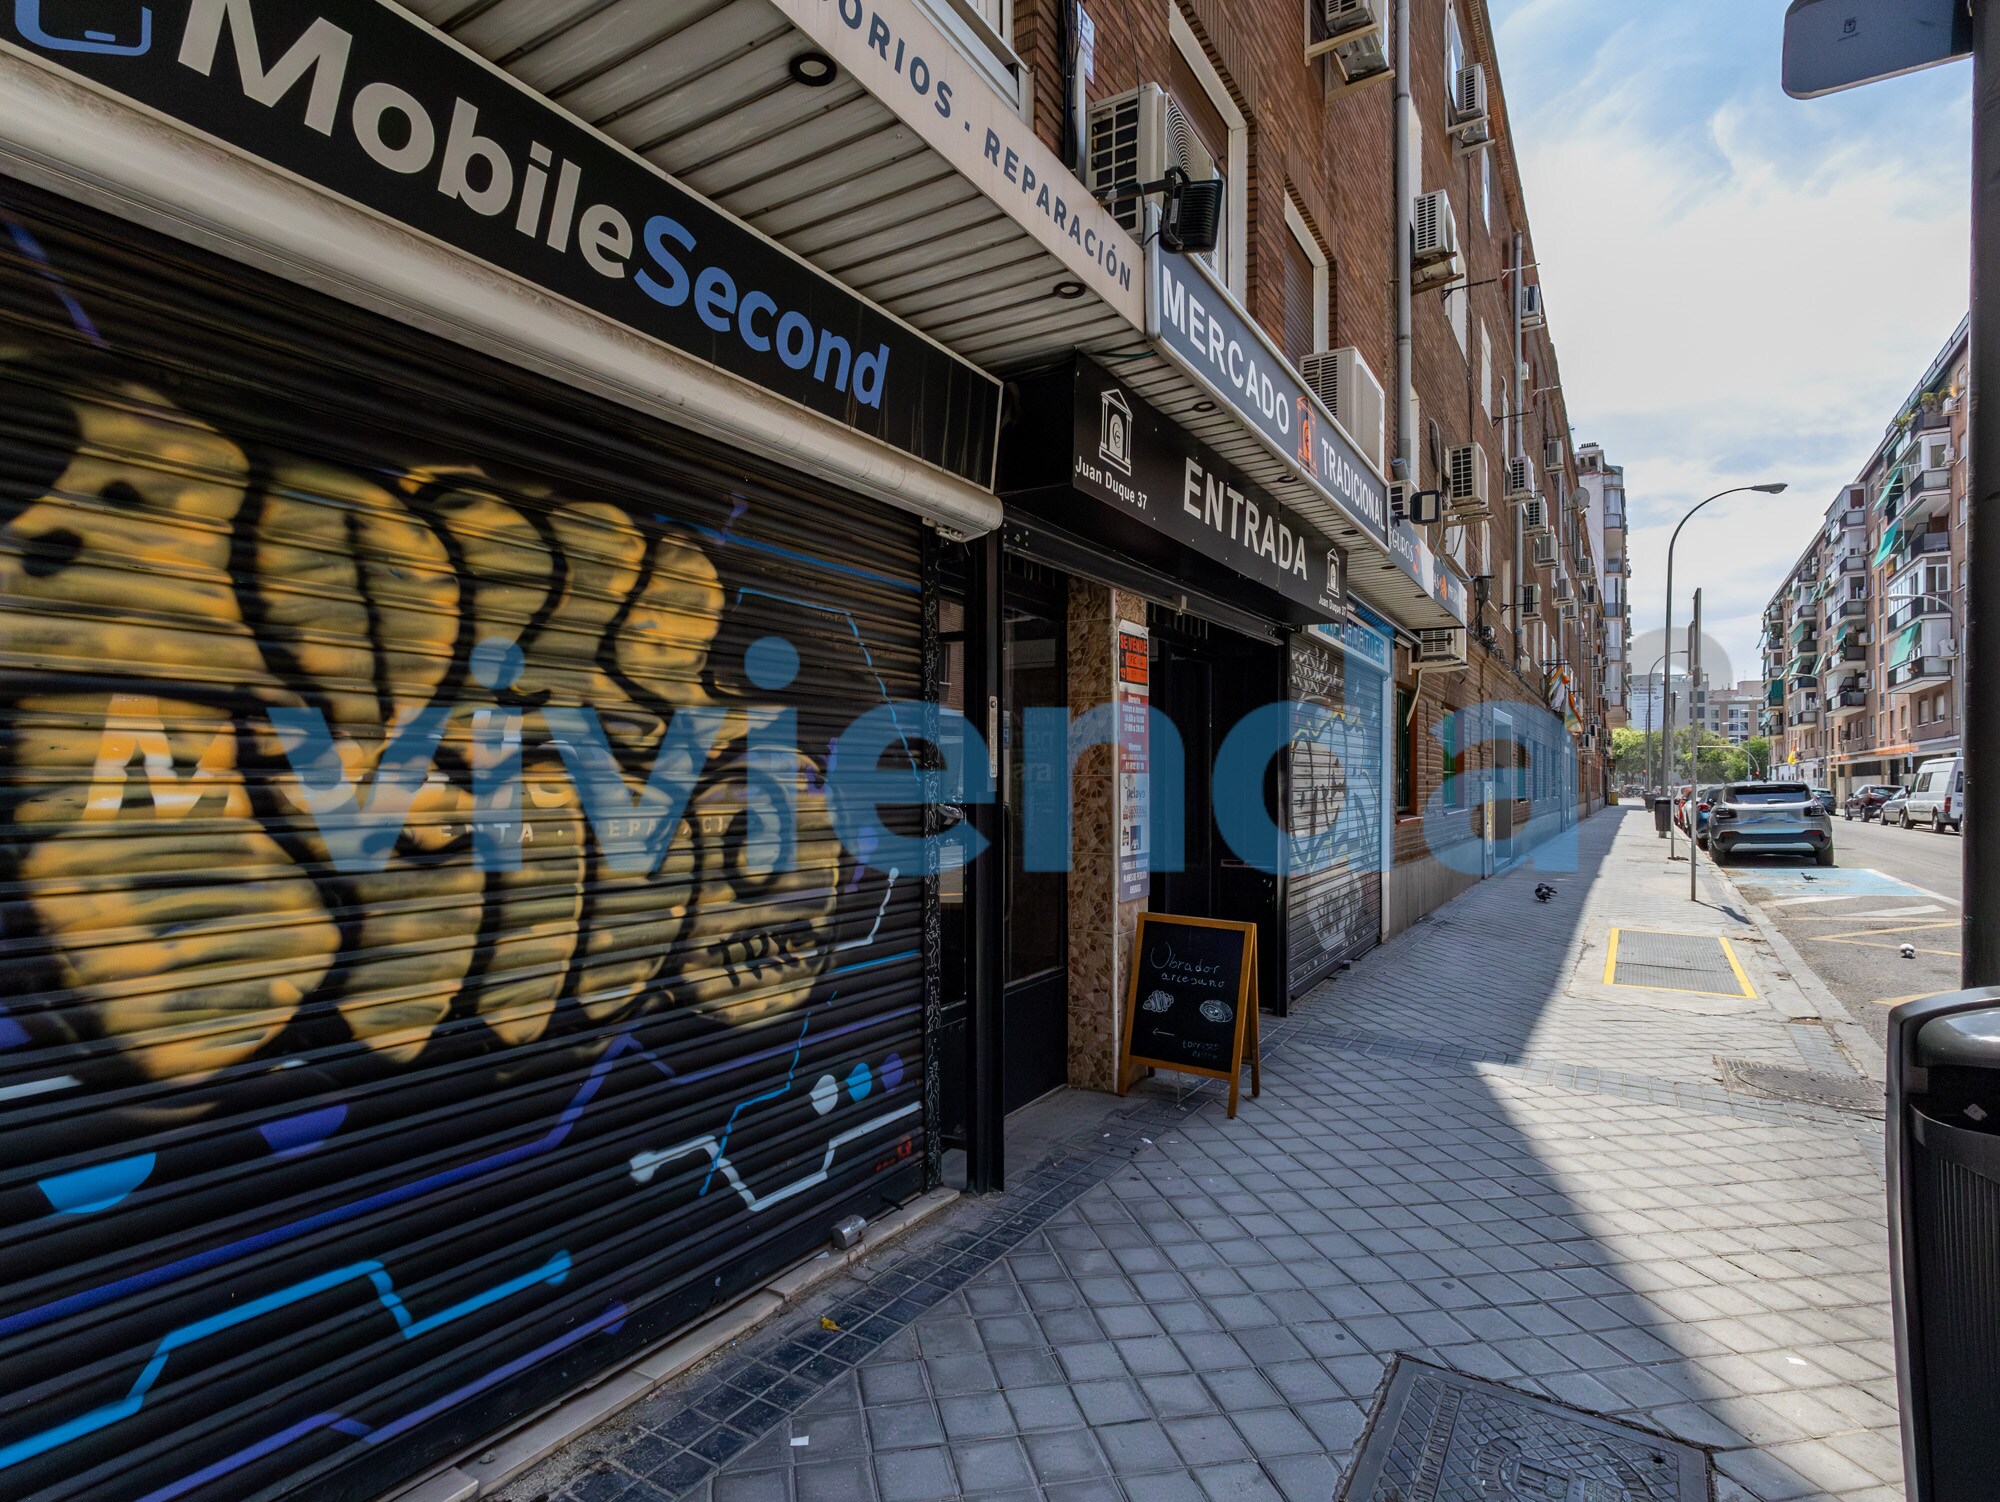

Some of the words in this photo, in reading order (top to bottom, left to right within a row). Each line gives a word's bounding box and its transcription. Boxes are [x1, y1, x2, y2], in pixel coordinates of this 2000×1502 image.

[838, 0, 953, 118] ORIOS
[984, 129, 1132, 292] REPARACIÓN
[178, 0, 889, 409] MobileSecond
[1162, 265, 1290, 436] MERCADO
[1321, 438, 1386, 532] TRADICIONAL
[1075, 456, 1102, 484] Juan
[1105, 471, 1135, 503] Duque
[1137, 491, 1147, 510] 37
[1183, 457, 1308, 581] ENTRADA
[1120, 634, 1128, 650] SE
[1128, 636, 1147, 655] VENDE
[1318, 594, 1329, 609] Juan
[1329, 599, 1341, 615] Duque
[1127, 787, 1146, 801] pelayo
